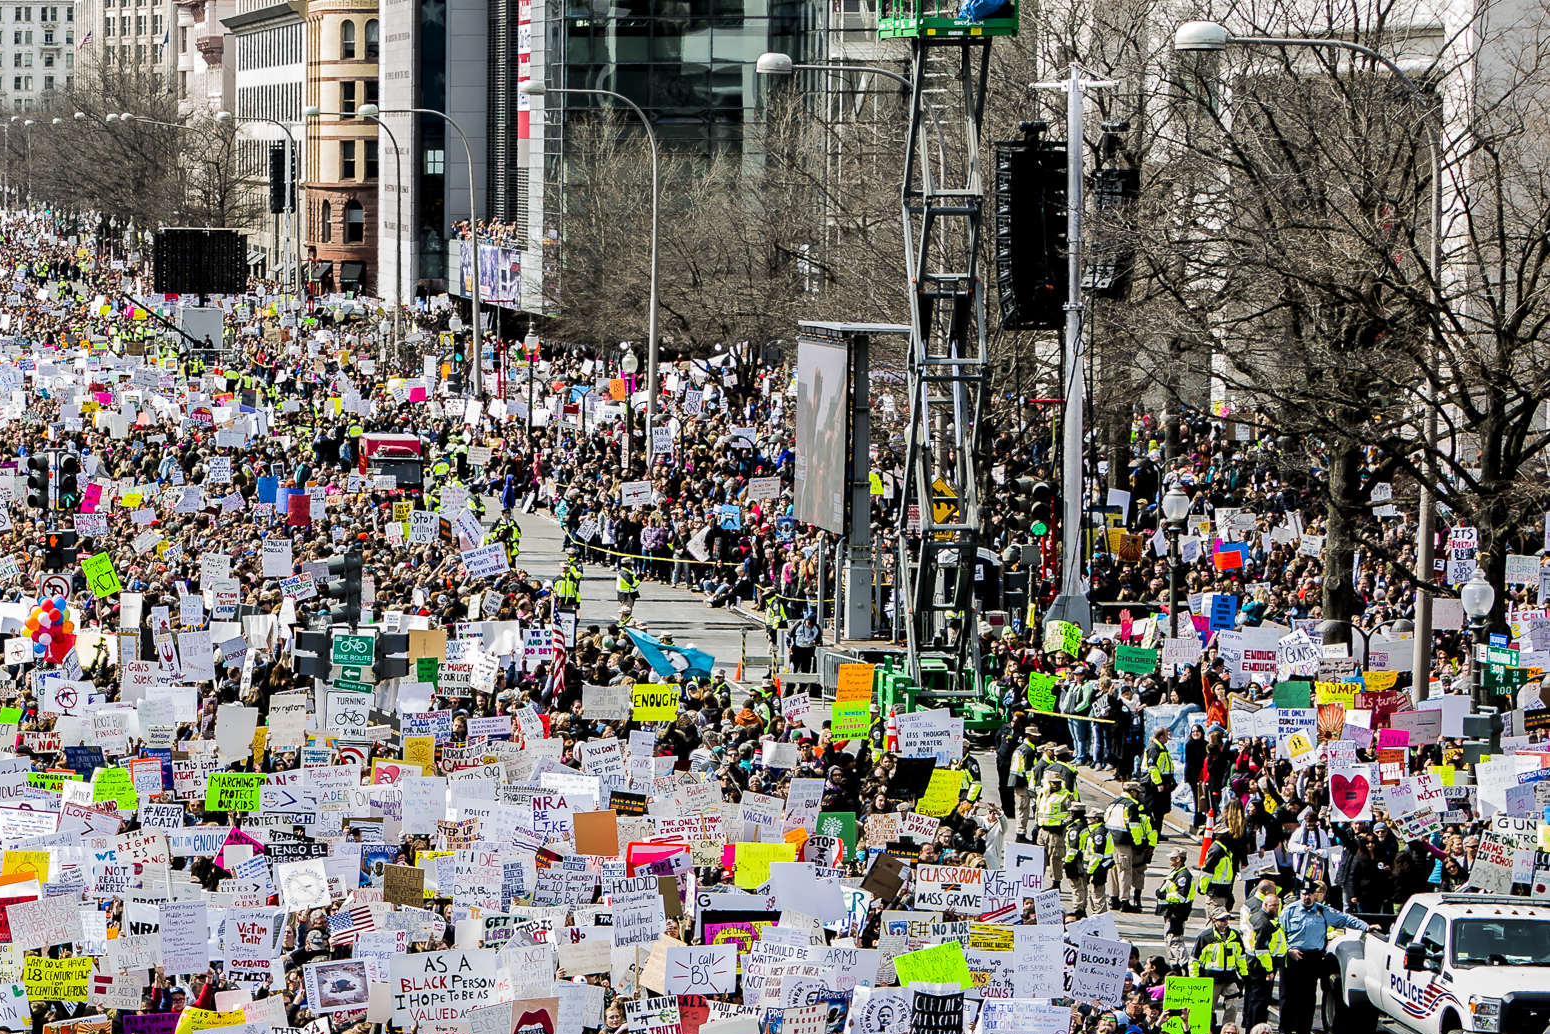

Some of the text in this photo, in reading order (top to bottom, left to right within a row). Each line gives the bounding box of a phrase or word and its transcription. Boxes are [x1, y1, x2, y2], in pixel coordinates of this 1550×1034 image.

[1495, 674, 1504, 683] 4
[1496, 687, 1512, 695] 100
[337, 696, 366, 706] TURNING
[632, 692, 678, 707] ENOUGH
[209, 775, 265, 788] MARCHING TO
[220, 788, 255, 800] PROTECT
[219, 799, 254, 810] OUR KIDS
[142, 805, 183, 817] #NEVER
[142, 816, 181, 828] AGAIN
[918, 866, 988, 883] CLASSROOM
[917, 893, 981, 909] MASS GRAVE
[1390, 973, 1424, 1006] POLICE
